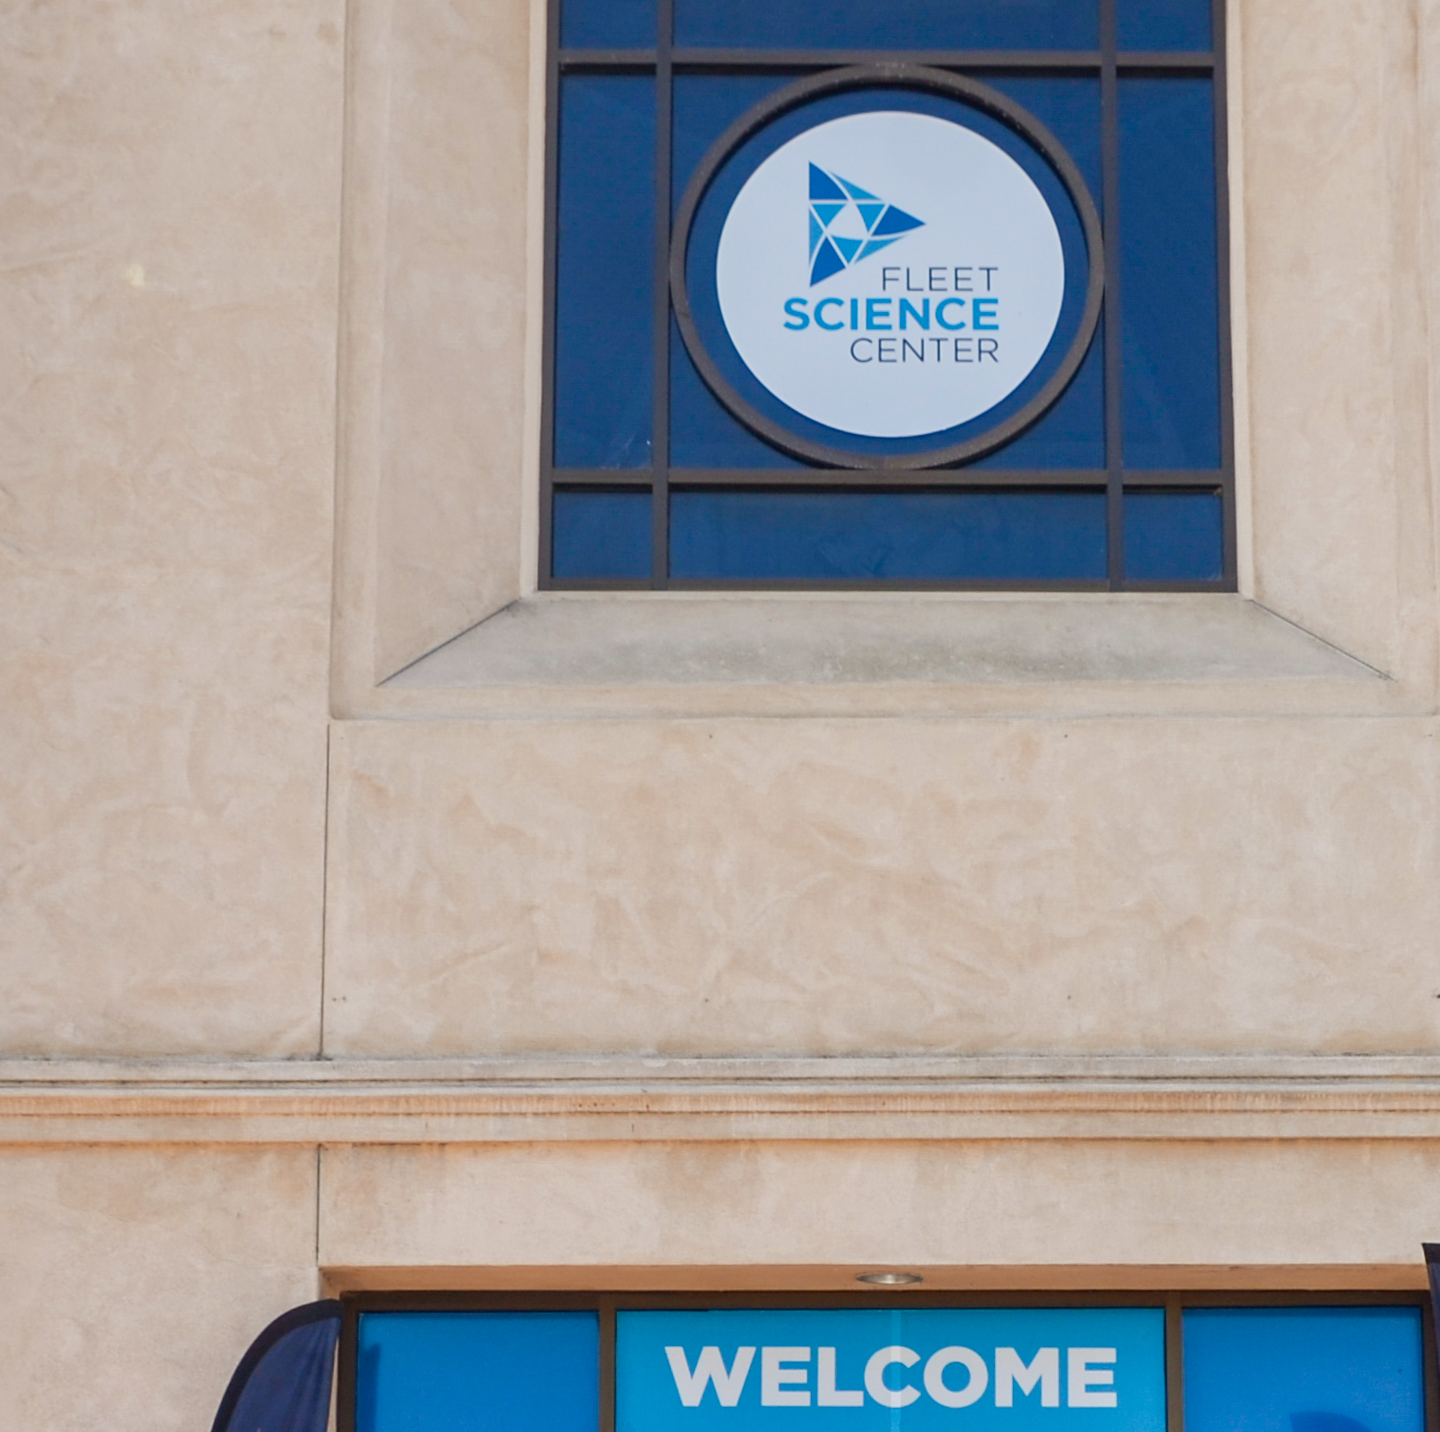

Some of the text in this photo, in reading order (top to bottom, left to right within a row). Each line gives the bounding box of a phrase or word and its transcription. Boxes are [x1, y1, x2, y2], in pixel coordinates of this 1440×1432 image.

[882, 266, 999, 292] FLEET
[783, 296, 999, 331] SCIENCE
[850, 337, 999, 363] CENTER
[664, 1344, 1118, 1409] WELCOME
